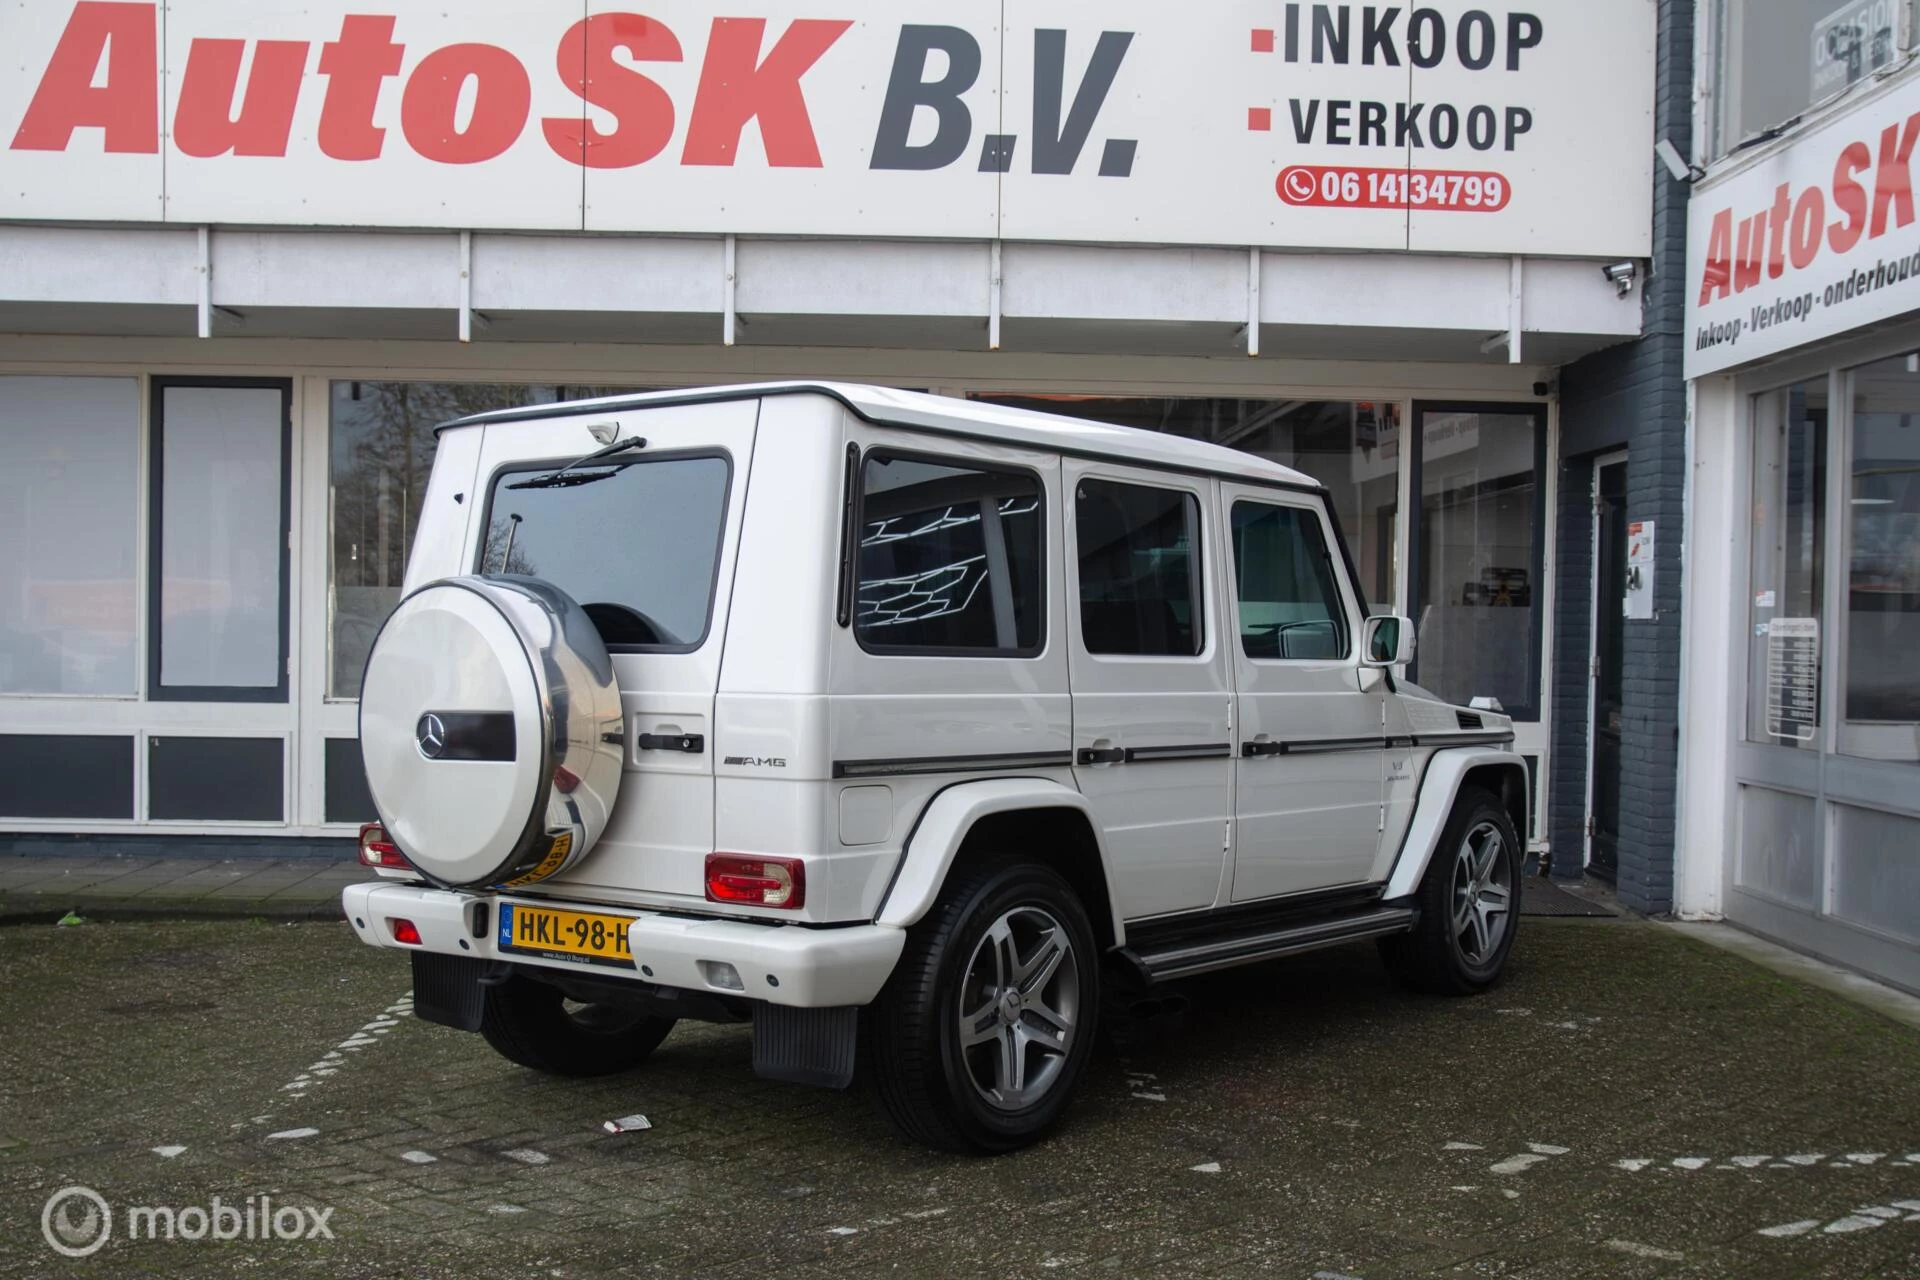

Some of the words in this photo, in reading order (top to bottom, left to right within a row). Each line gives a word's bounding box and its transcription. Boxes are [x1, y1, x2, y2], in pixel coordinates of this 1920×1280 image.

[1285, 3, 1543, 71] INKOOP
[9, 0, 855, 169] AutoSK
[869, 24, 1137, 177] B.V.
[1288, 98, 1533, 151] VERKOOP
[1321, 171, 1360, 202] 06
[1367, 172, 1502, 206] 14134799
[1697, 110, 1920, 307] AutoSK
[1696, 318, 1741, 351] Inkoop
[1751, 292, 1812, 332] Verkoop
[502, 928, 511, 938] NL
[520, 912, 631, 954] HKL-98-H
